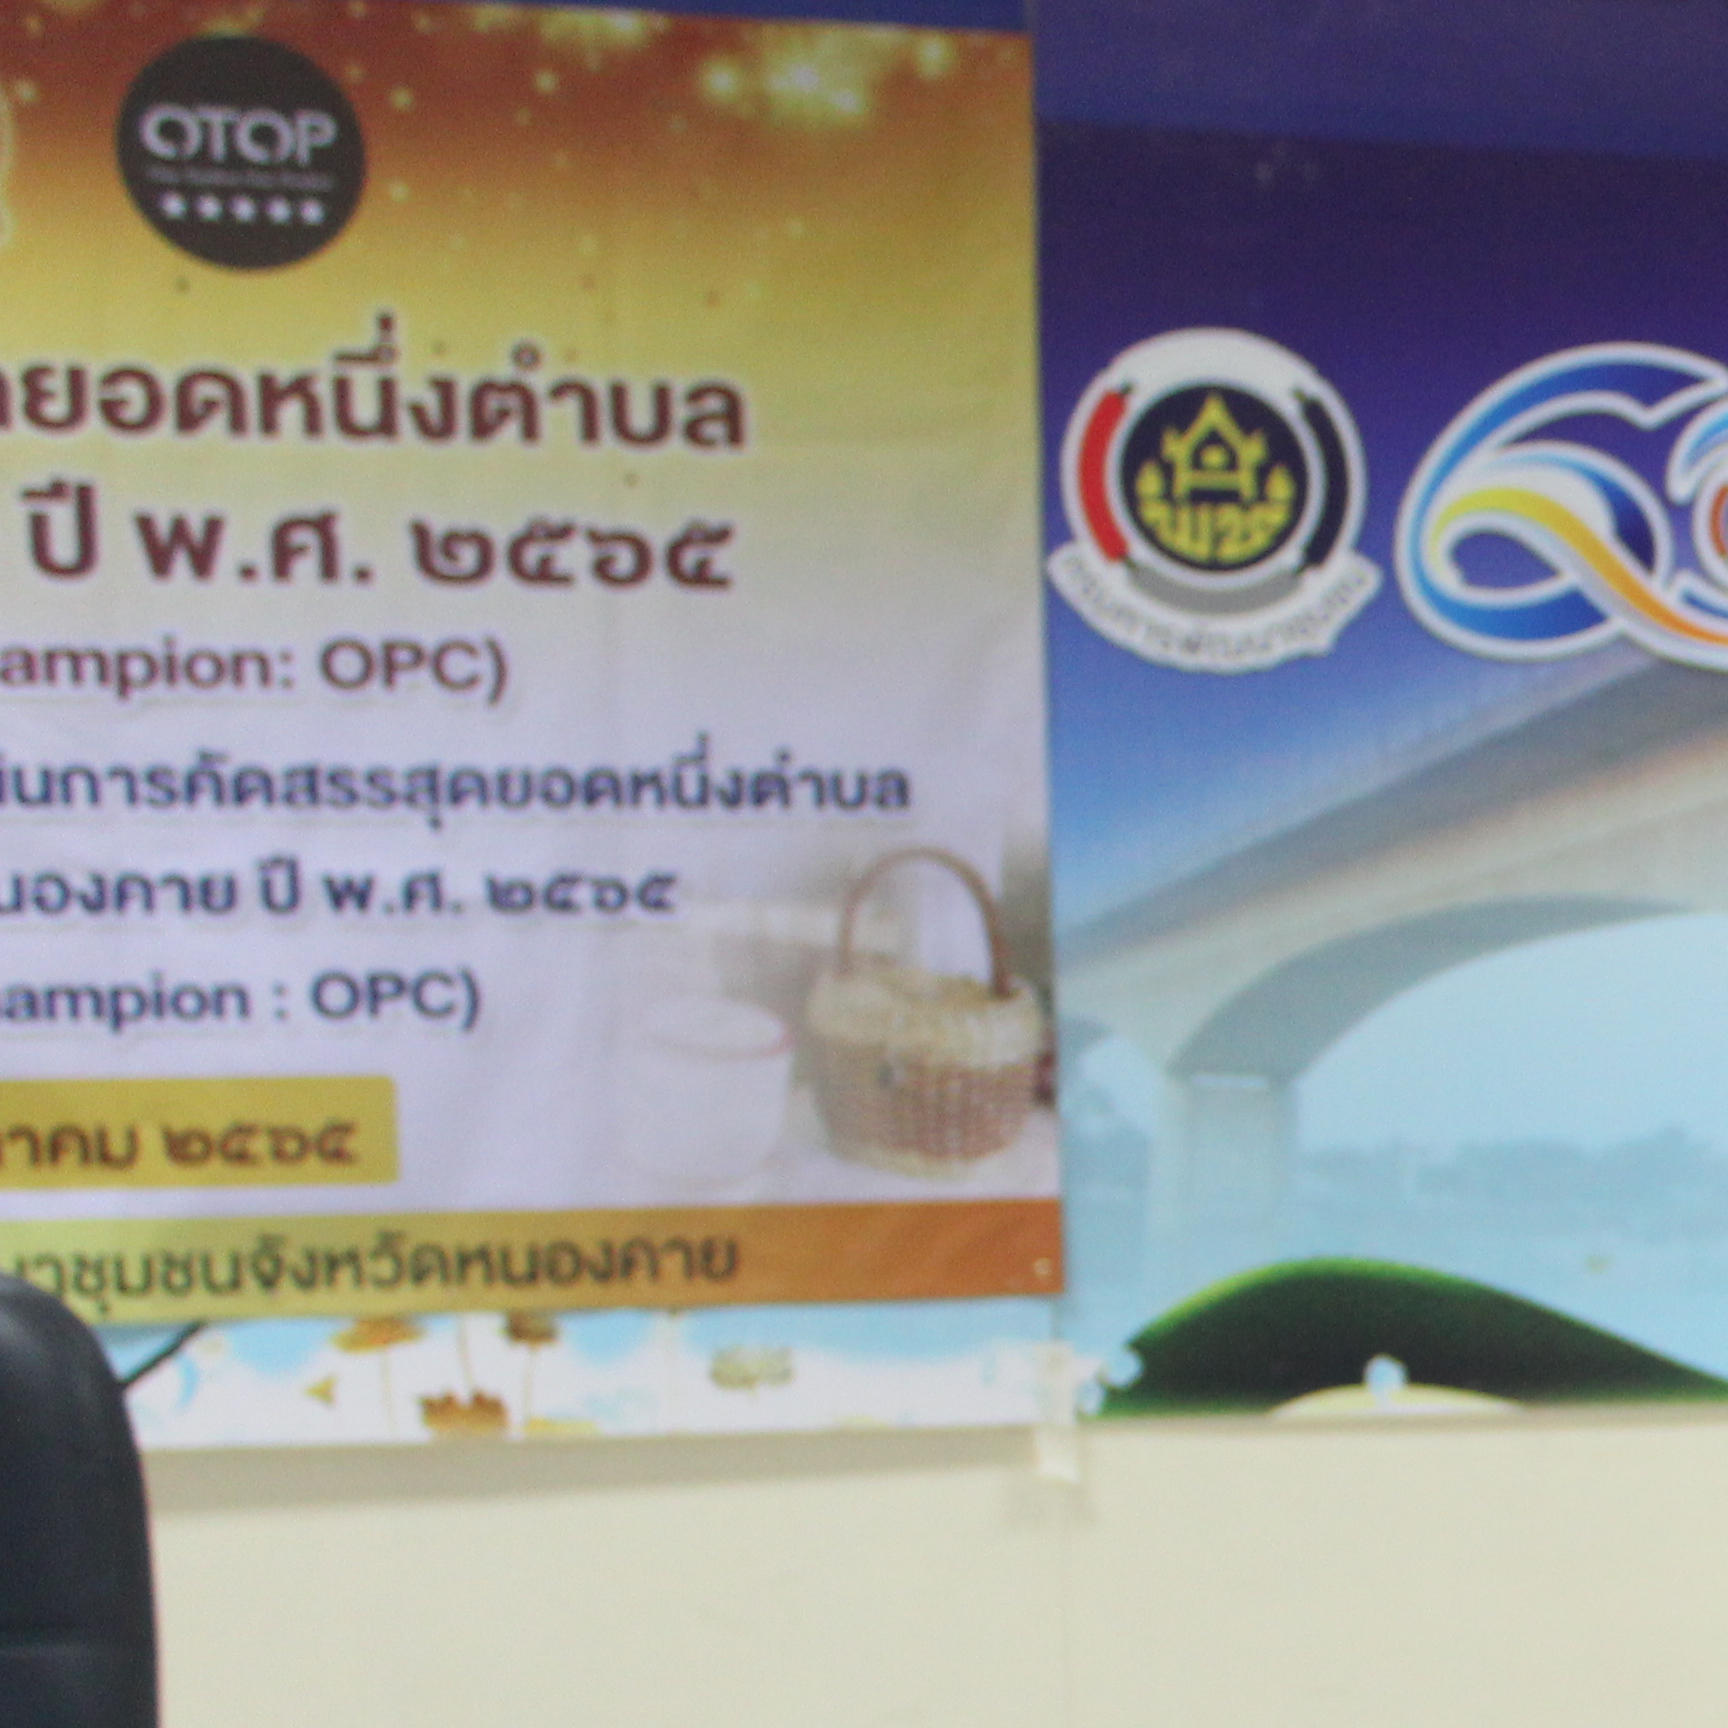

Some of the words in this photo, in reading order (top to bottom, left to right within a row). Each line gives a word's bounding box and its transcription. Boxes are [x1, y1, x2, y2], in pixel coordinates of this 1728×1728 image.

[139, 103, 338, 166] OTOP
[0, 312, 746, 448] ยอดหนึ่งตำบล
[20, 478, 98, 579] ปี
[133, 507, 374, 584] พ.ศ.
[409, 515, 735, 589] ๒๕๖๕
[319, 637, 510, 706] OPC)
[0, 732, 914, 832] นการคัดสรรสุดยอดหนึ่งตำบล
[256, 855, 301, 915] ปี
[322, 869, 464, 914] พ.ศ.
[311, 965, 481, 1033] OPC)
[0, 1121, 140, 1171] าคม
